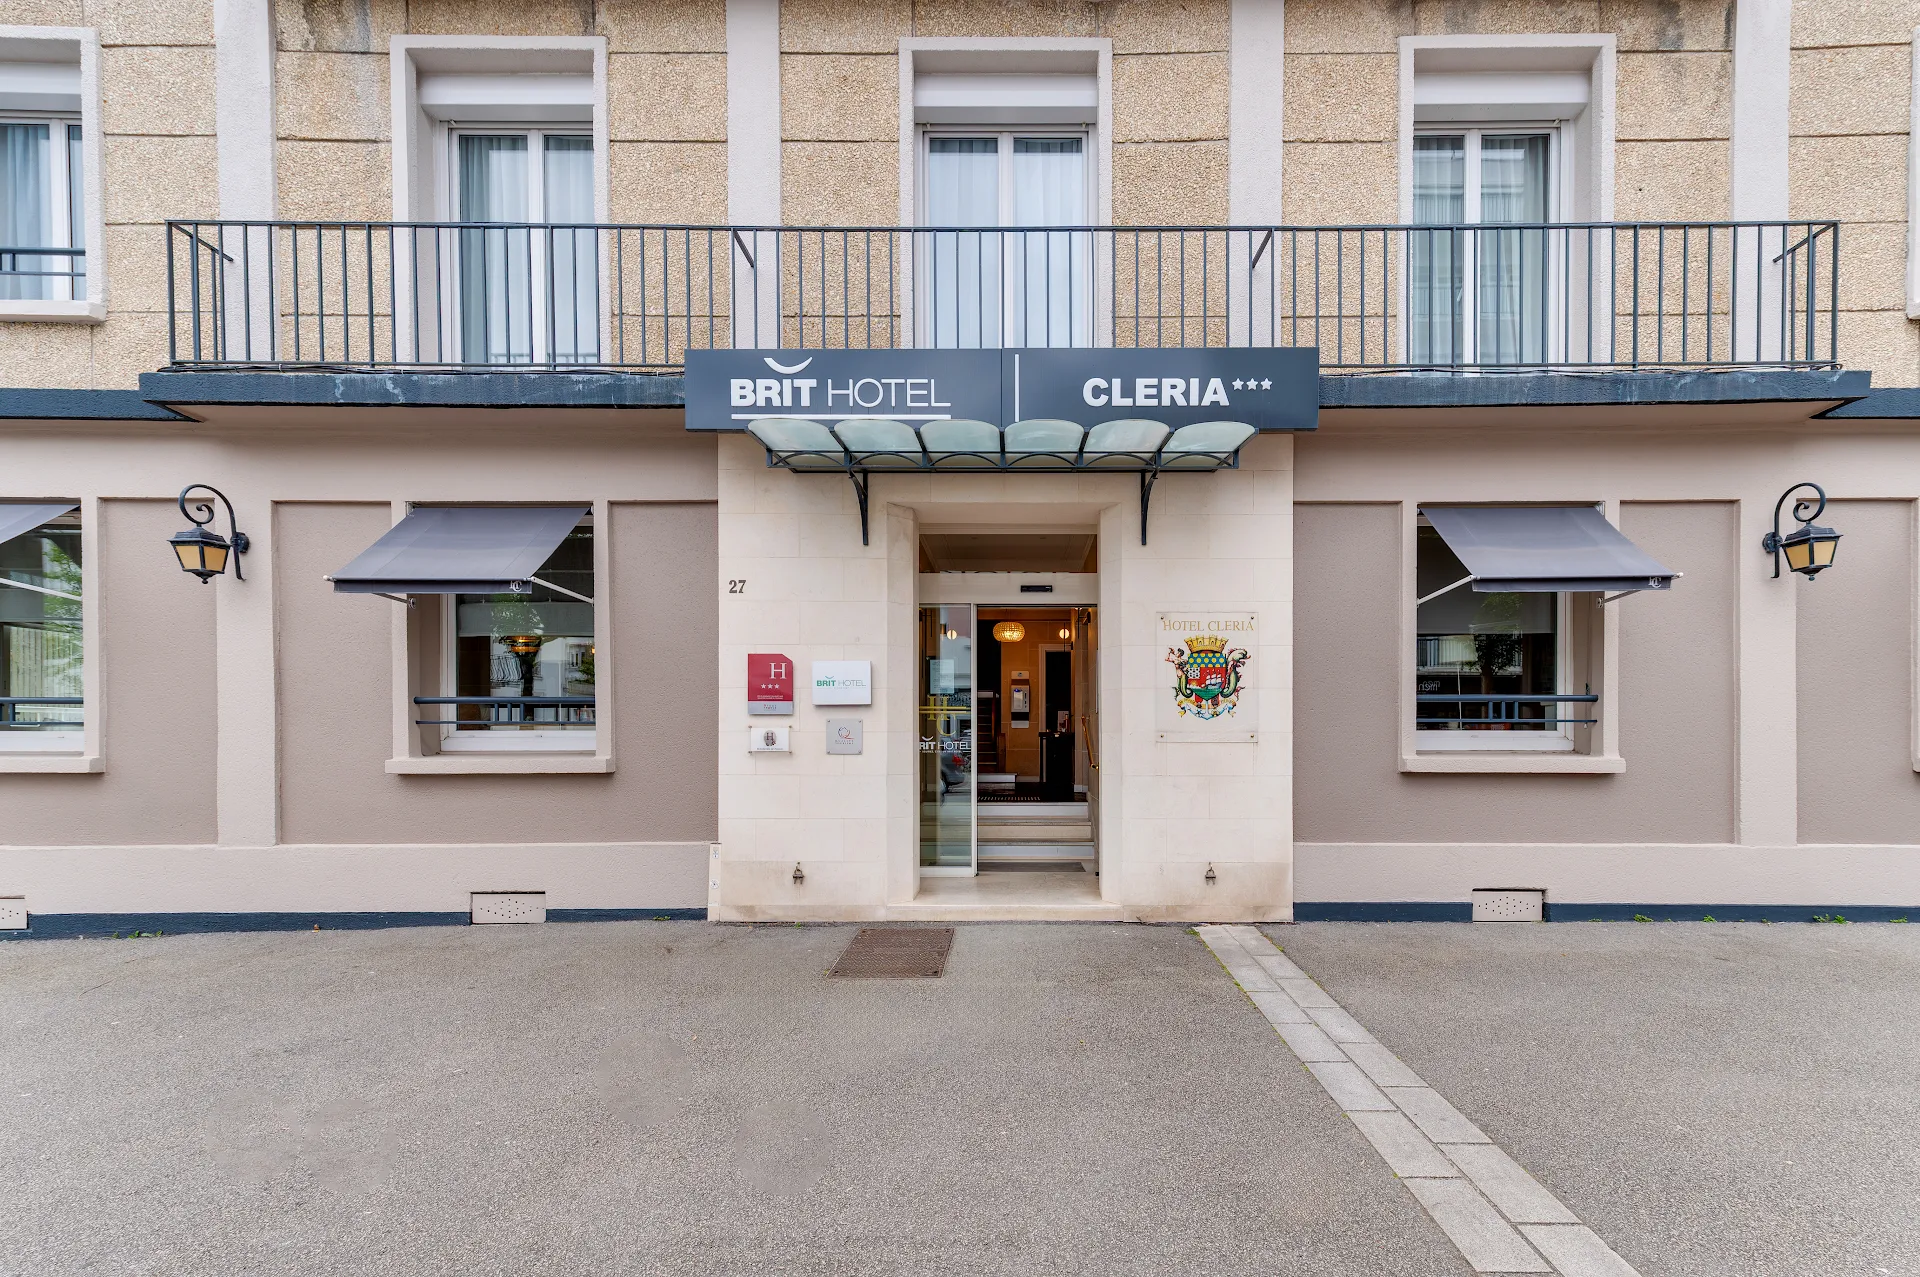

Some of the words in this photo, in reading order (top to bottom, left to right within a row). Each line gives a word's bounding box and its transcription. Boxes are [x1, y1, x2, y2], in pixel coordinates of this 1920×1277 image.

[730, 378, 817, 407] BRIT
[827, 378, 951, 408] HOTEL
[1083, 377, 1230, 407] CLERIA
[728, 579, 747, 594] 27
[1162, 619, 1204, 632] HOTEL
[1208, 620, 1254, 632] CLERIA
[769, 662, 787, 680] H
[838, 679, 867, 687] HOTEL
[919, 741, 936, 750] RIT
[938, 741, 972, 750] HOTEL
